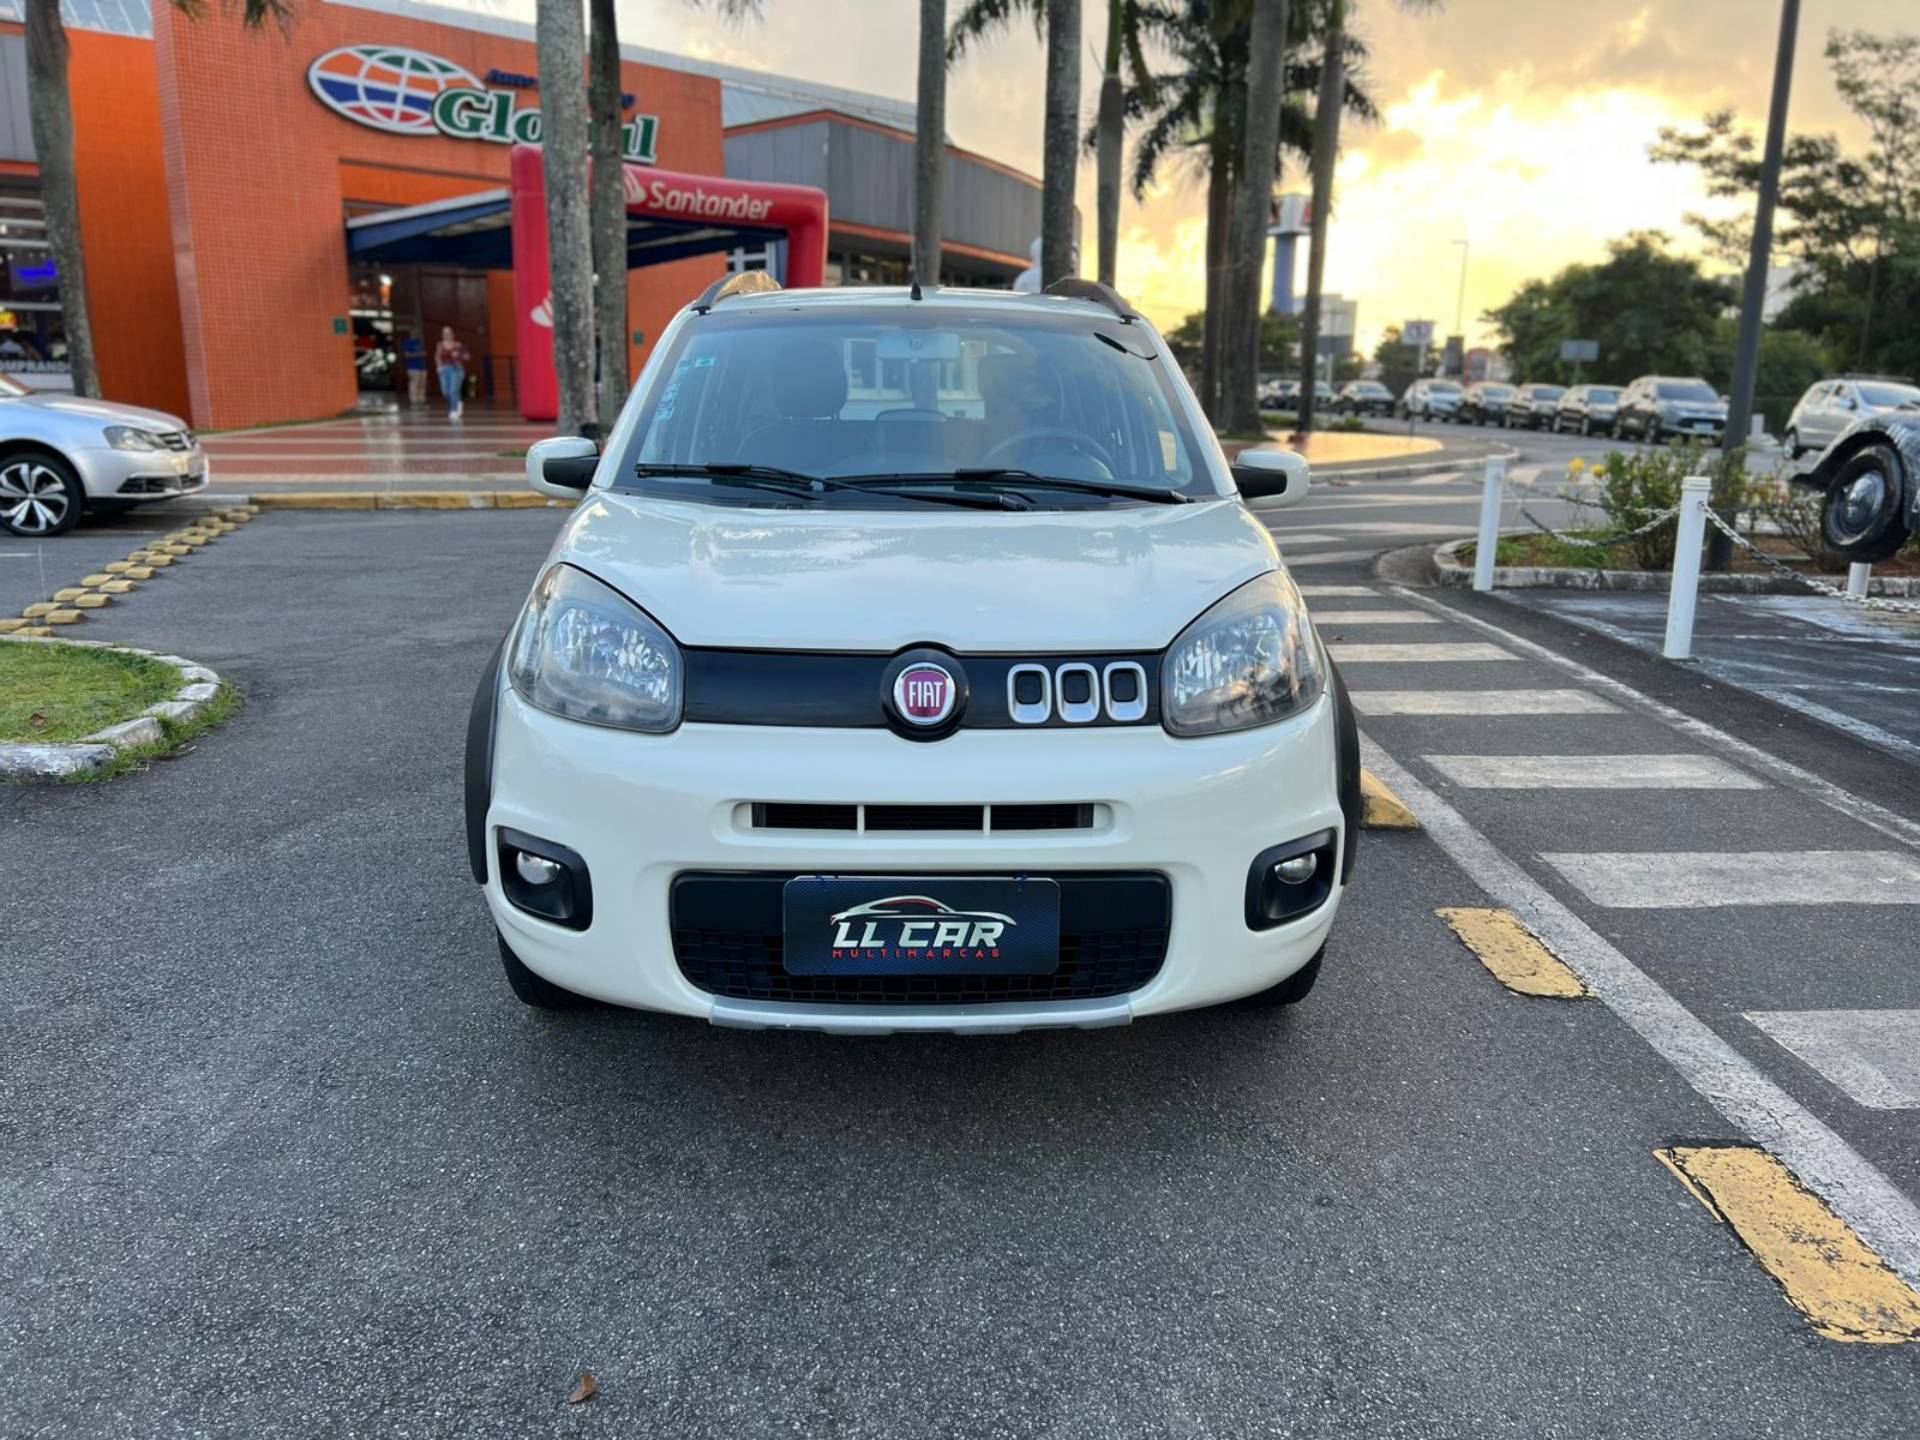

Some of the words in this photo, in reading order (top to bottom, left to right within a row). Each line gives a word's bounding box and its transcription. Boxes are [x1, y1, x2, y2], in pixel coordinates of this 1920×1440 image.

[433, 88, 659, 164] Glol
[648, 181, 773, 220] Santander
[908, 681, 943, 708] FIAT
[832, 921, 886, 948] LL
[898, 921, 1005, 948] CAR
[831, 948, 1001, 959] MULTIMARCAS
